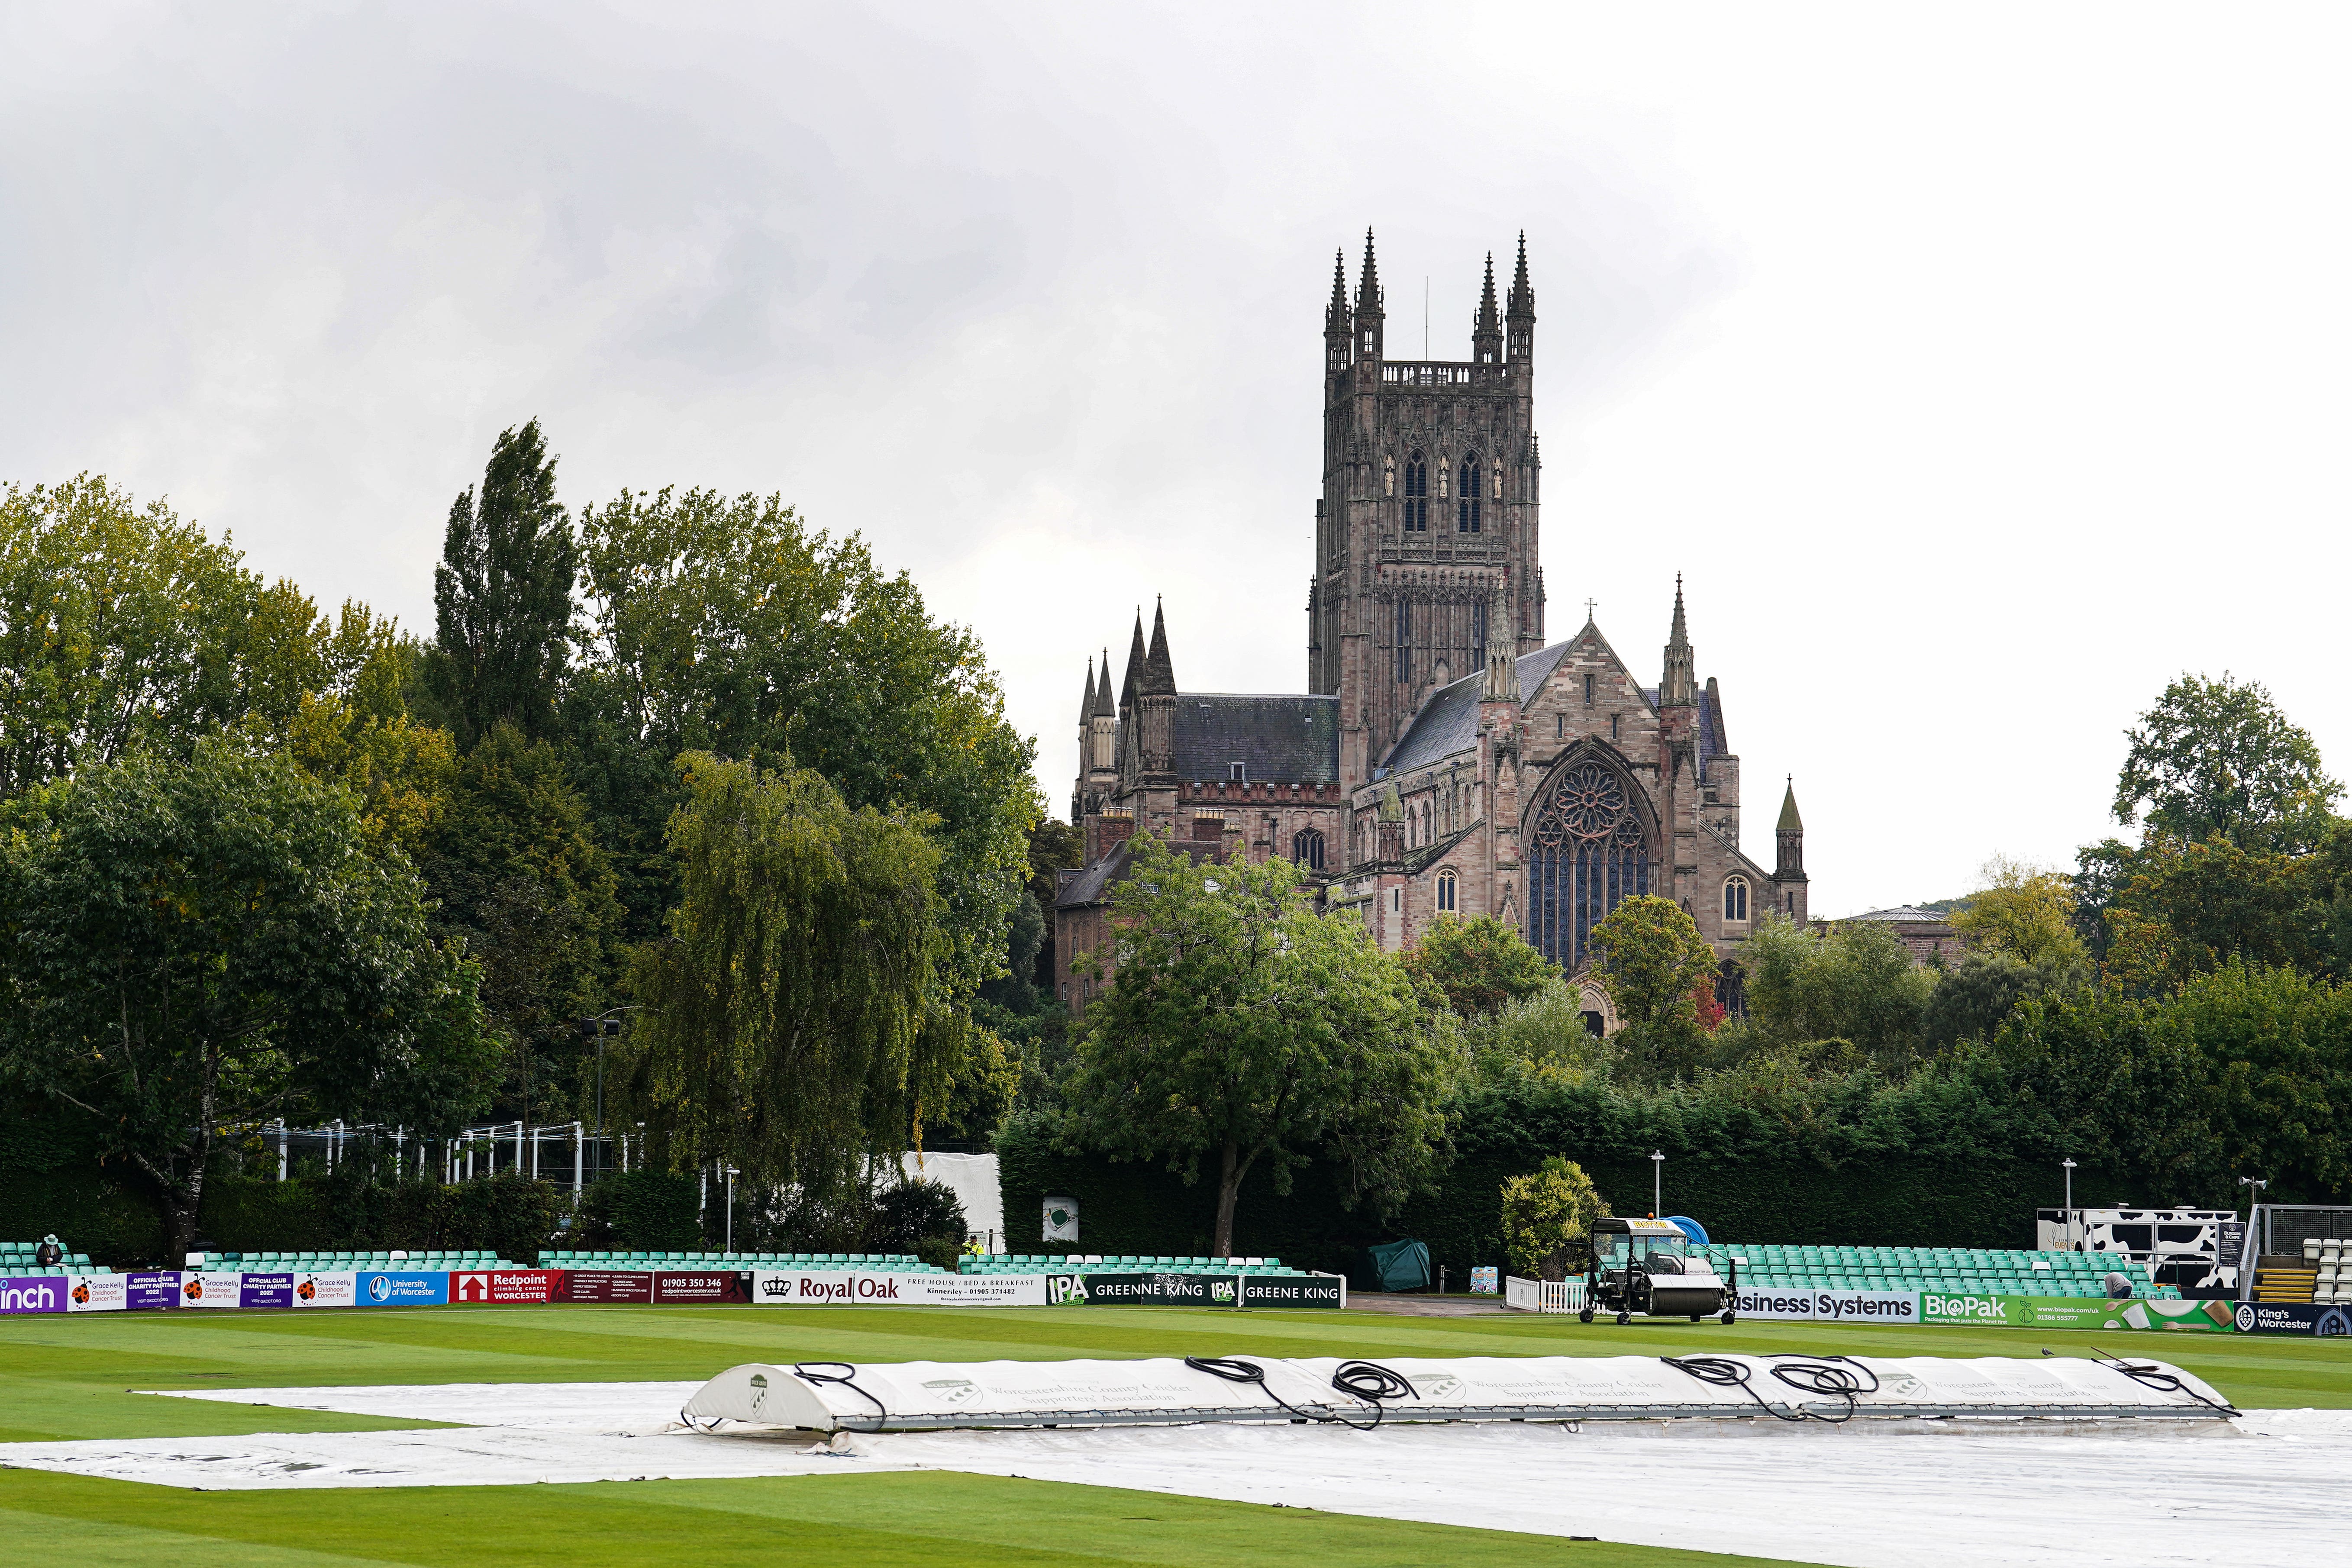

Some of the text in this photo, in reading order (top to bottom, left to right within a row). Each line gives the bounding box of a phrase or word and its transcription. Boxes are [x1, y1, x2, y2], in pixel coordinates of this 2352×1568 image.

[392, 1280, 427, 1289] University
[494, 1274, 547, 1287] Redpoint
[662, 1278, 721, 1287] 01905 350 346
[0, 1280, 54, 1309] inch
[800, 1278, 899, 1303] Royal Oak
[1049, 1274, 1090, 1303] IPA
[1167, 1284, 1203, 1296] KING
[1211, 1281, 1236, 1298] IPA
[1246, 1287, 1338, 1299] GREENE KING
[1734, 1292, 1912, 1318] usiness Systems
[1925, 1295, 2006, 1317] BioPak
[2258, 1309, 2289, 1320] King’s
[2258, 1319, 2311, 1329] Worcester
[987, 1383, 1193, 1395] Worcestershire County Cricket
[1469, 1379, 1665, 1389] Worcestershire County Cricket
[1102, 1394, 1175, 1403] Association
[1579, 1389, 1649, 1397] Association
